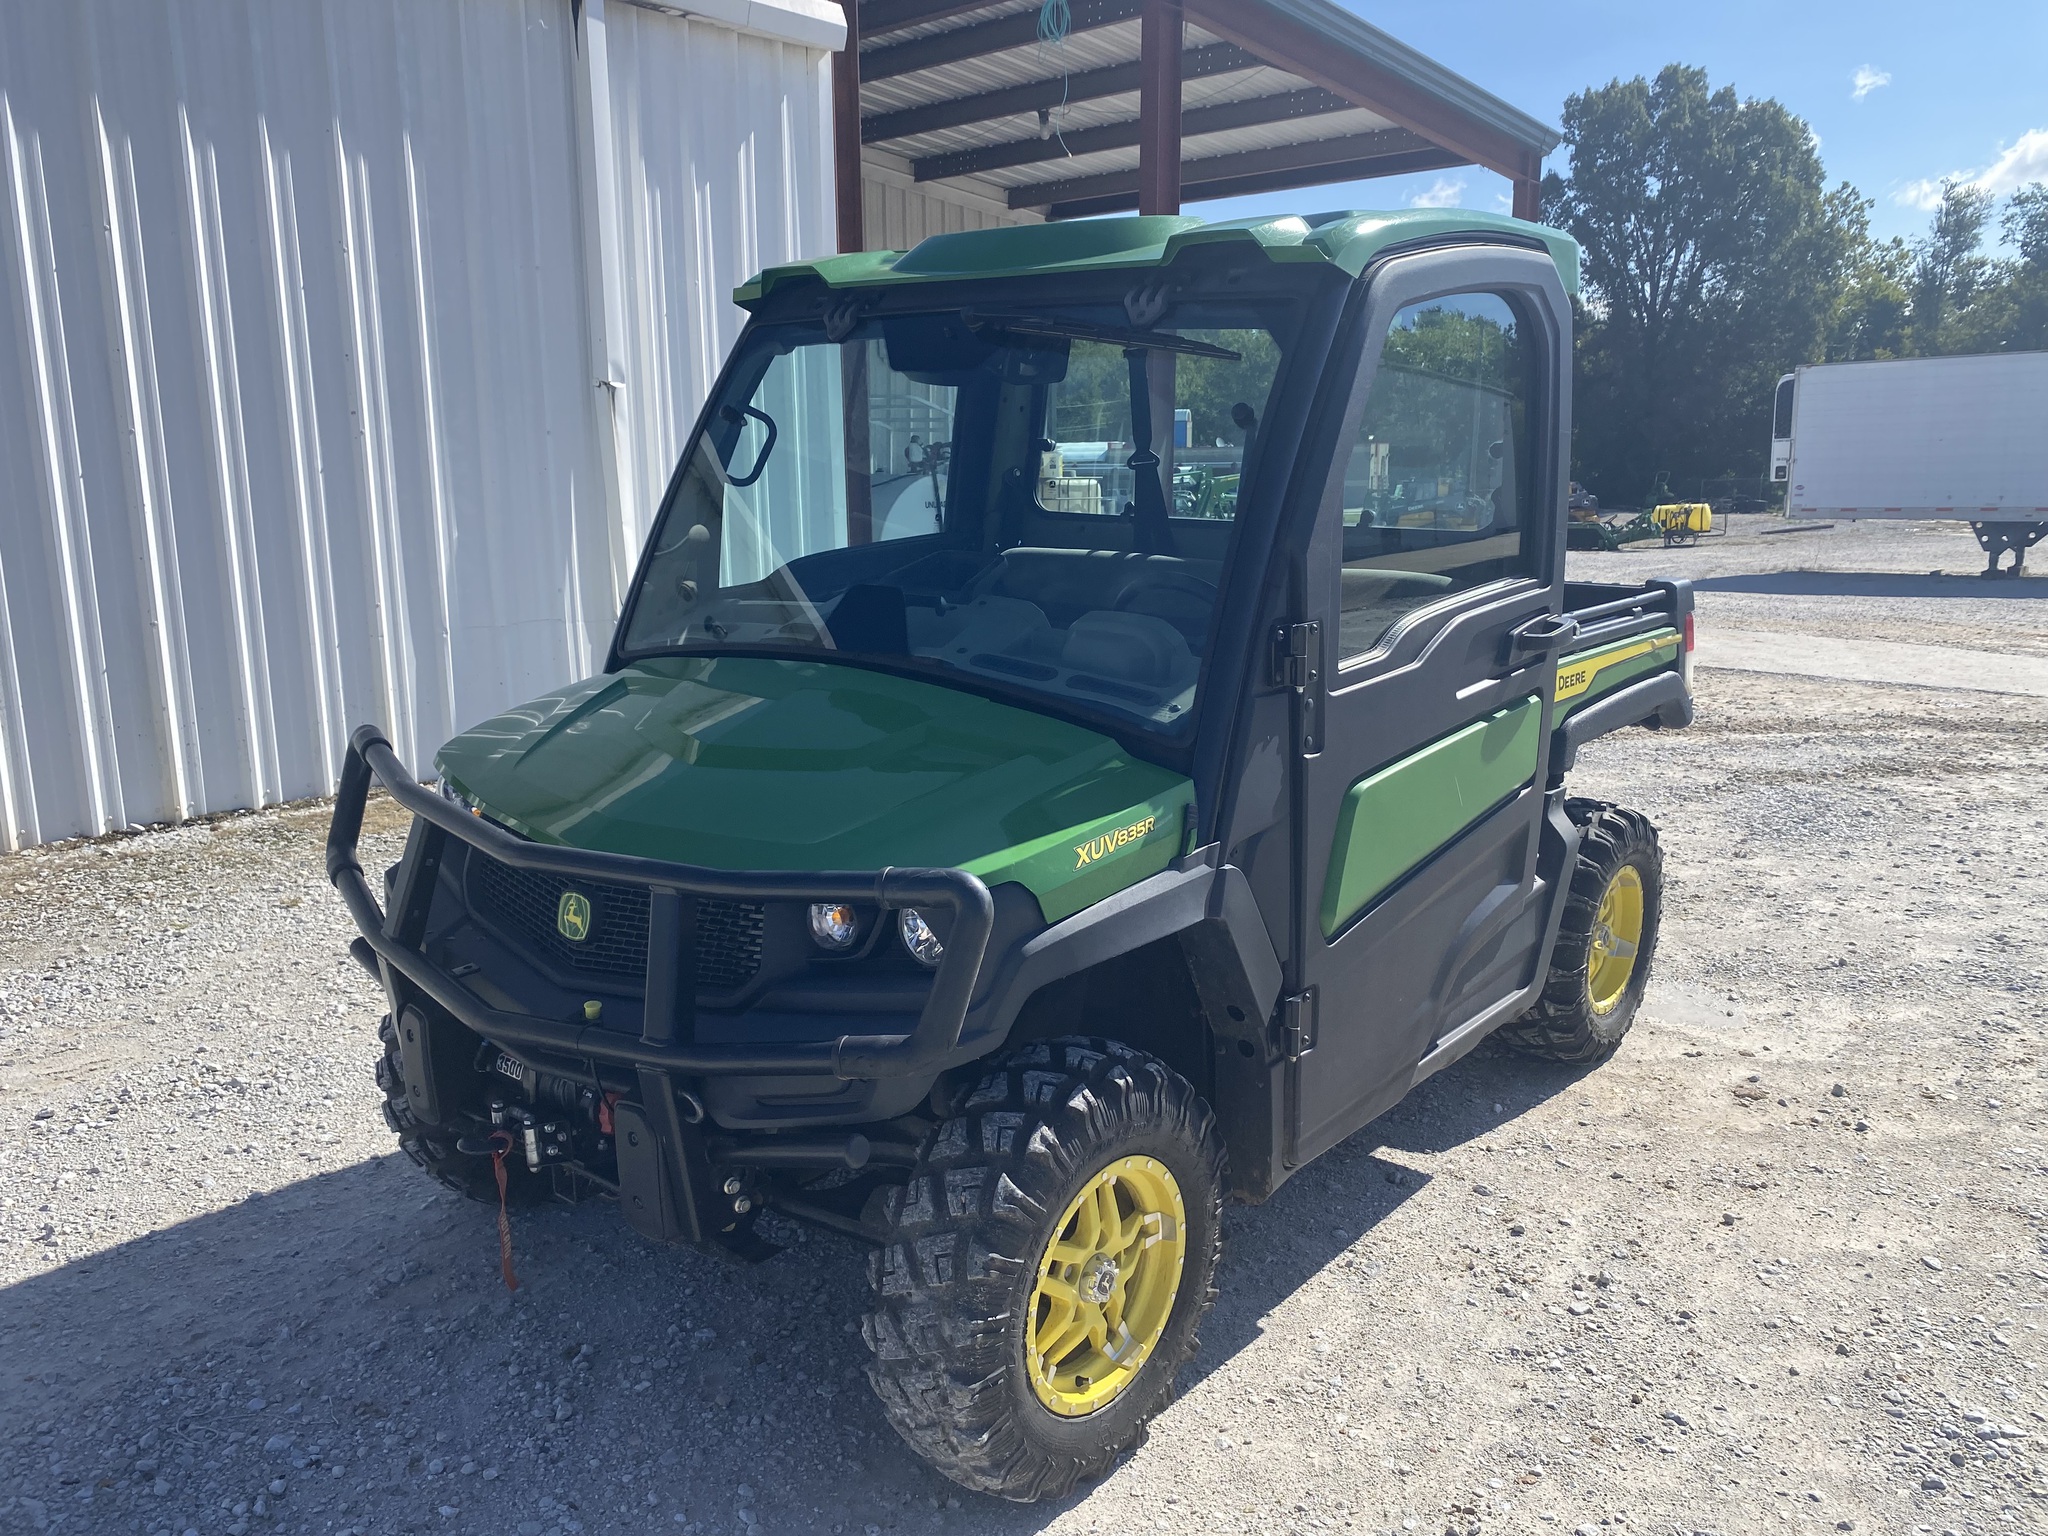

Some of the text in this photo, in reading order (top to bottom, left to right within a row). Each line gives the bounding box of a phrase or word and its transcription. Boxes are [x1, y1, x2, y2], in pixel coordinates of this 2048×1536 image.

[1558, 671, 1586, 691] DEERE
[1074, 816, 1155, 870] XUV835R
[497, 1054, 523, 1079] 3500
